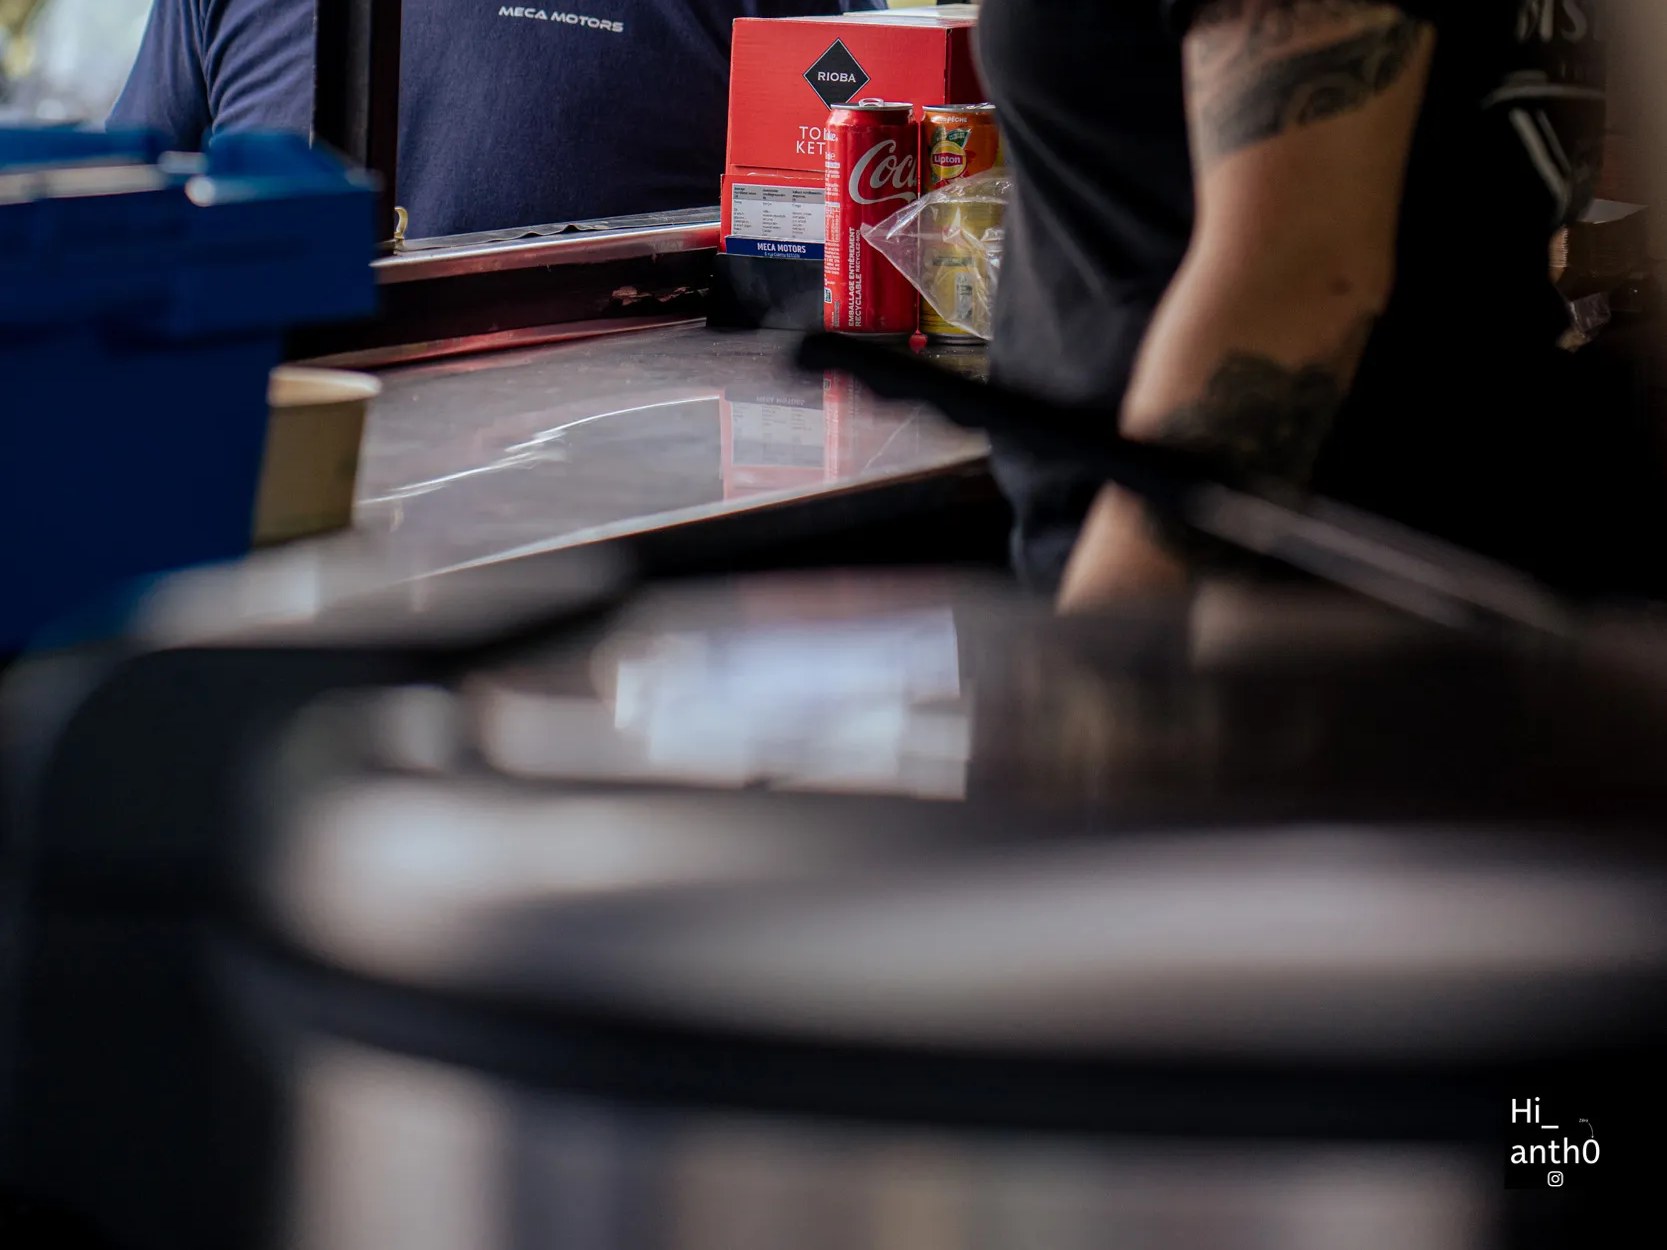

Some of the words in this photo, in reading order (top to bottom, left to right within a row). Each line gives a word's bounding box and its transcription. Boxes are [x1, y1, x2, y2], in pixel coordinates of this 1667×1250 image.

[498, 5, 548, 21] MECA
[551, 11, 624, 33] MOTORS
[817, 71, 857, 83] RIOBA
[799, 125, 829, 141] TO
[934, 155, 961, 164] Lipton
[757, 243, 776, 251] MECA
[777, 244, 806, 253] MOTORS
